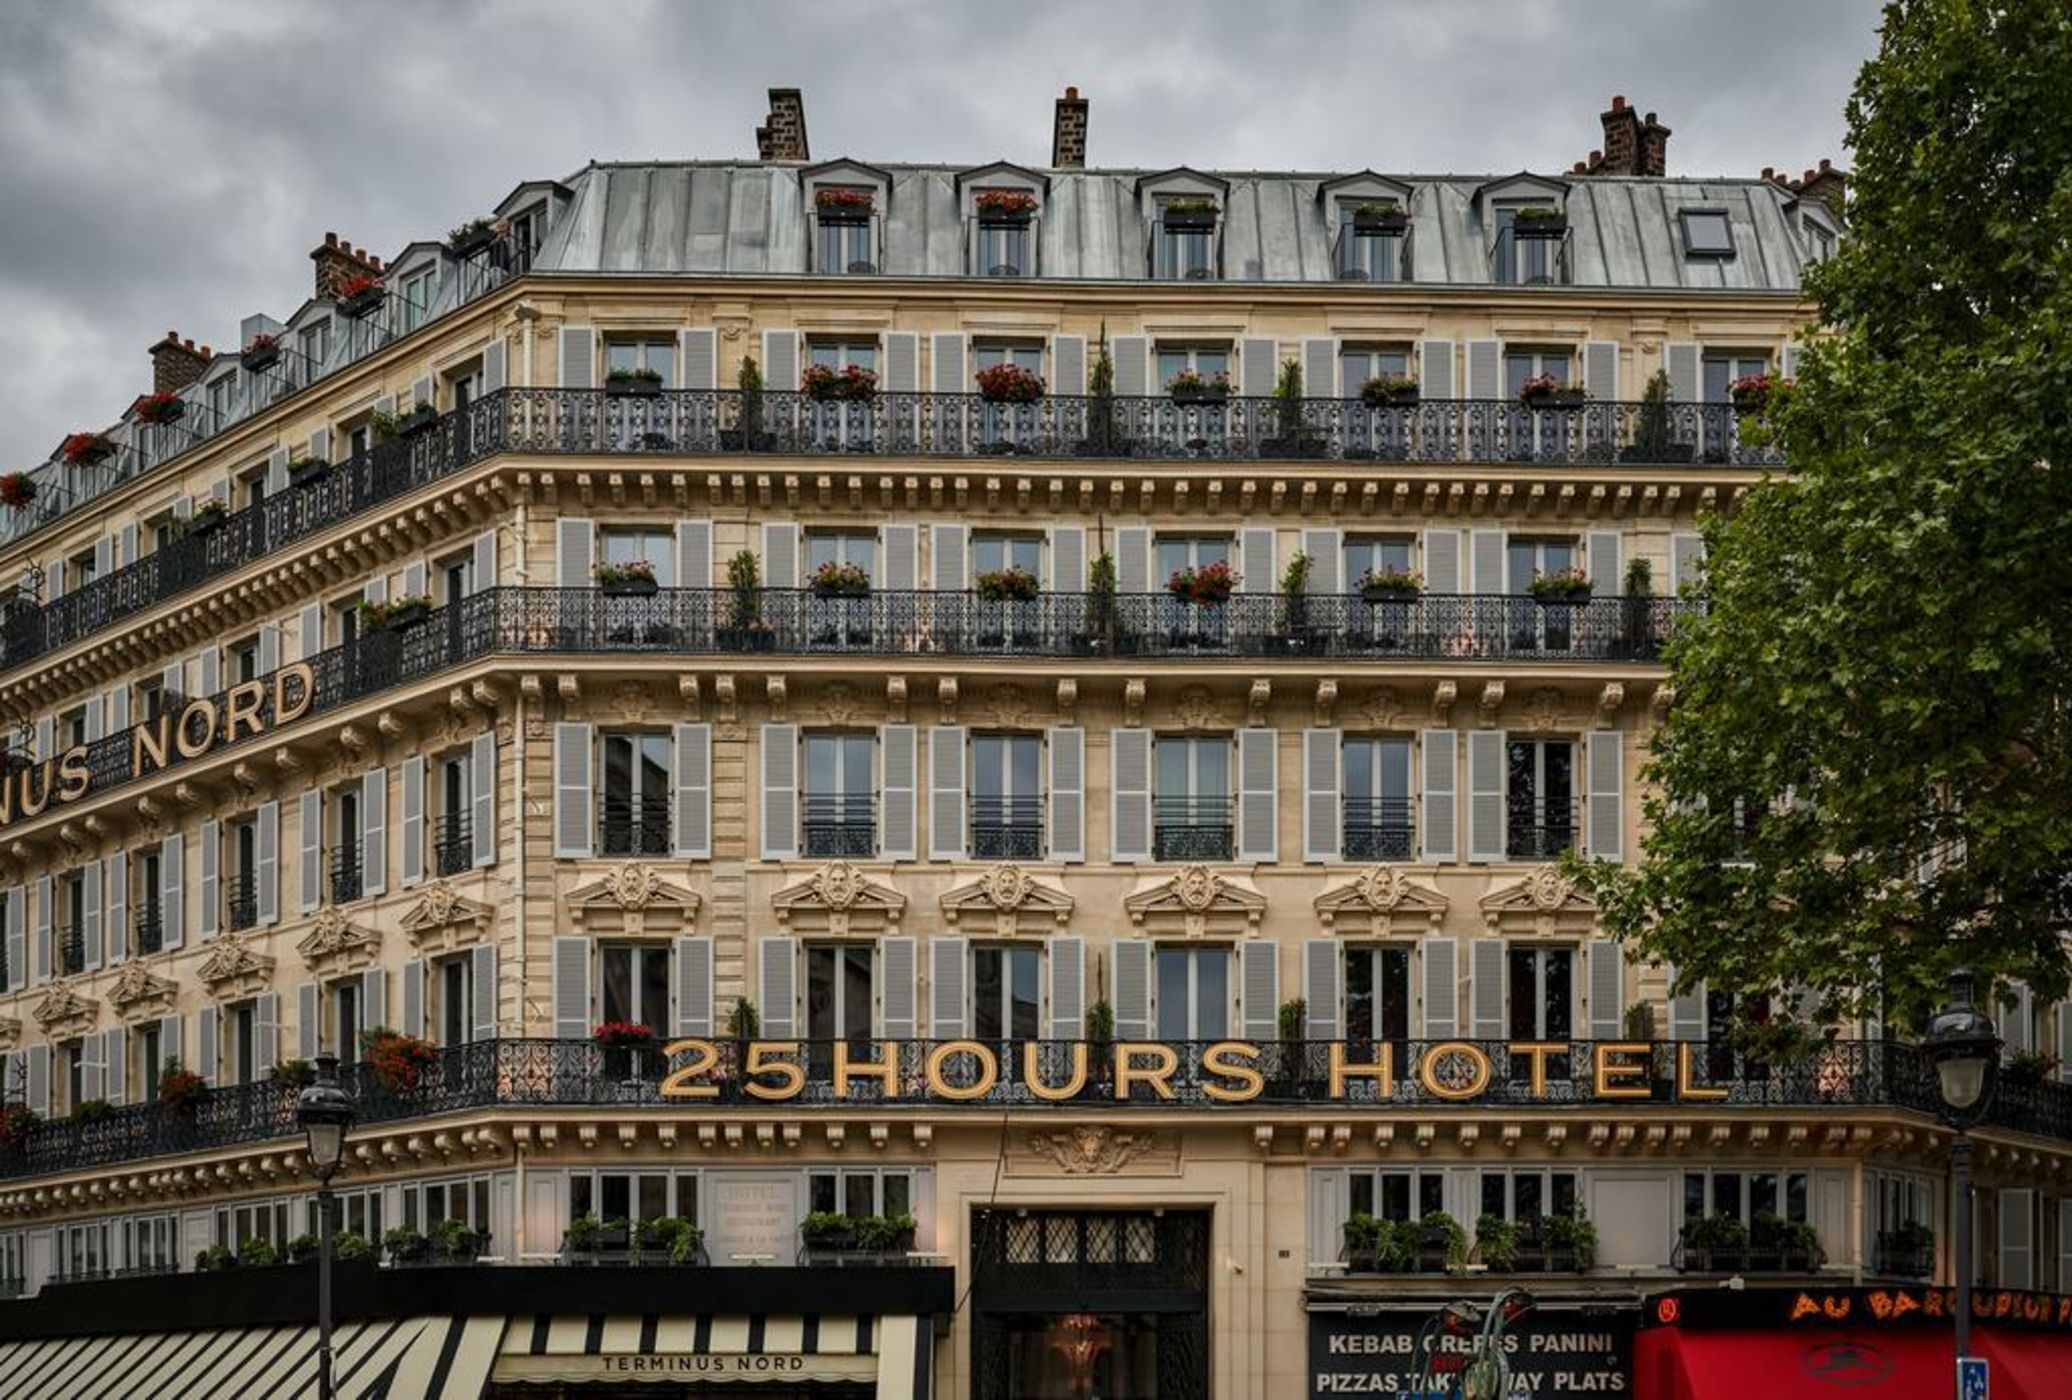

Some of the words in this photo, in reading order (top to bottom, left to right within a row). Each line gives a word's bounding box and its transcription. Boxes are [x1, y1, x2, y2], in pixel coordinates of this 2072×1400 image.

[132, 662, 315, 777] NORD
[1328, 1041, 1729, 1099] HOTEL
[1790, 1290, 1851, 1321] AU
[1328, 1335, 1413, 1354] KEBAB
[1530, 1335, 1613, 1353] PANINI
[604, 1357, 724, 1371] TERMINUS
[737, 1357, 805, 1371] NORD
[1316, 1373, 1399, 1392] PIZZAS
[1405, 1373, 1464, 1391] TAK
[1553, 1372, 1626, 1391] PLATS
